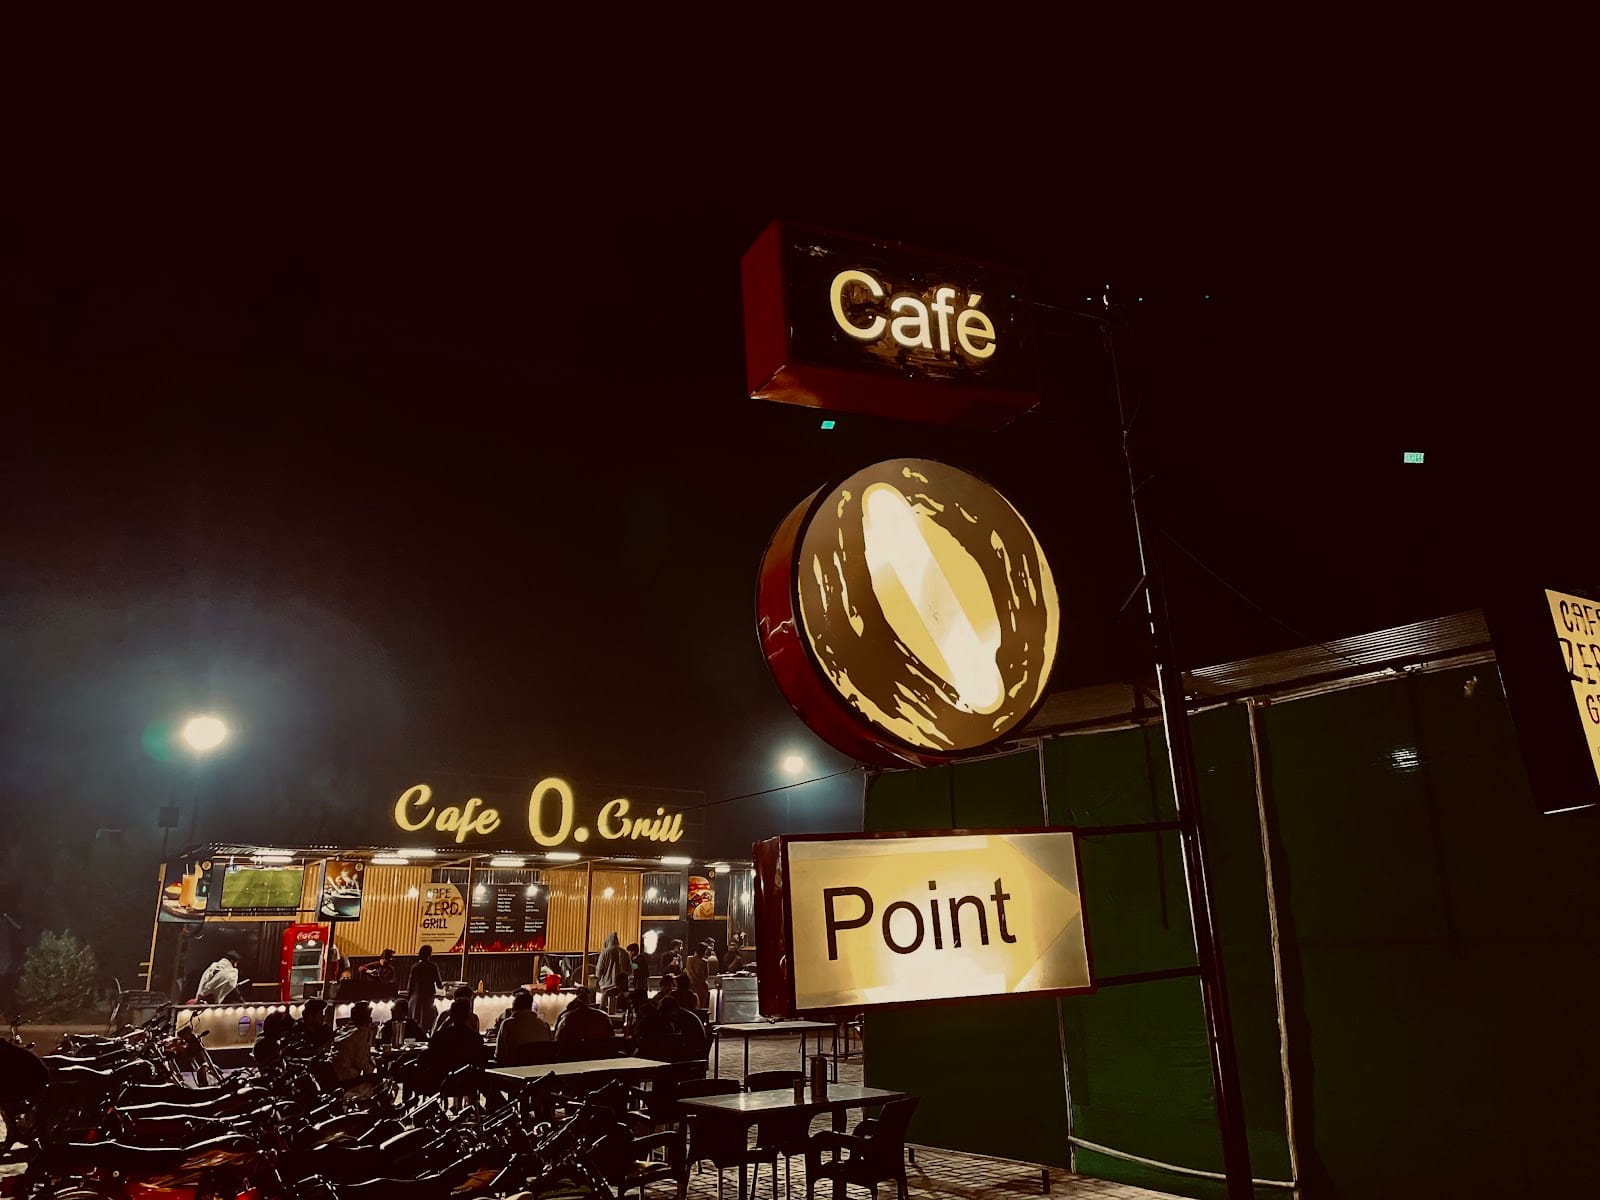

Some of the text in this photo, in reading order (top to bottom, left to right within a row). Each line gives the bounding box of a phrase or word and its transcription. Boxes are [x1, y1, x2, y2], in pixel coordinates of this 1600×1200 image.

[830, 269, 997, 359] Café
[1586, 694, 1600, 725] G
[394, 784, 500, 843] Cafe
[597, 798, 684, 842] Grill
[423, 918, 448, 929] GRILL
[823, 877, 1017, 961] Point
